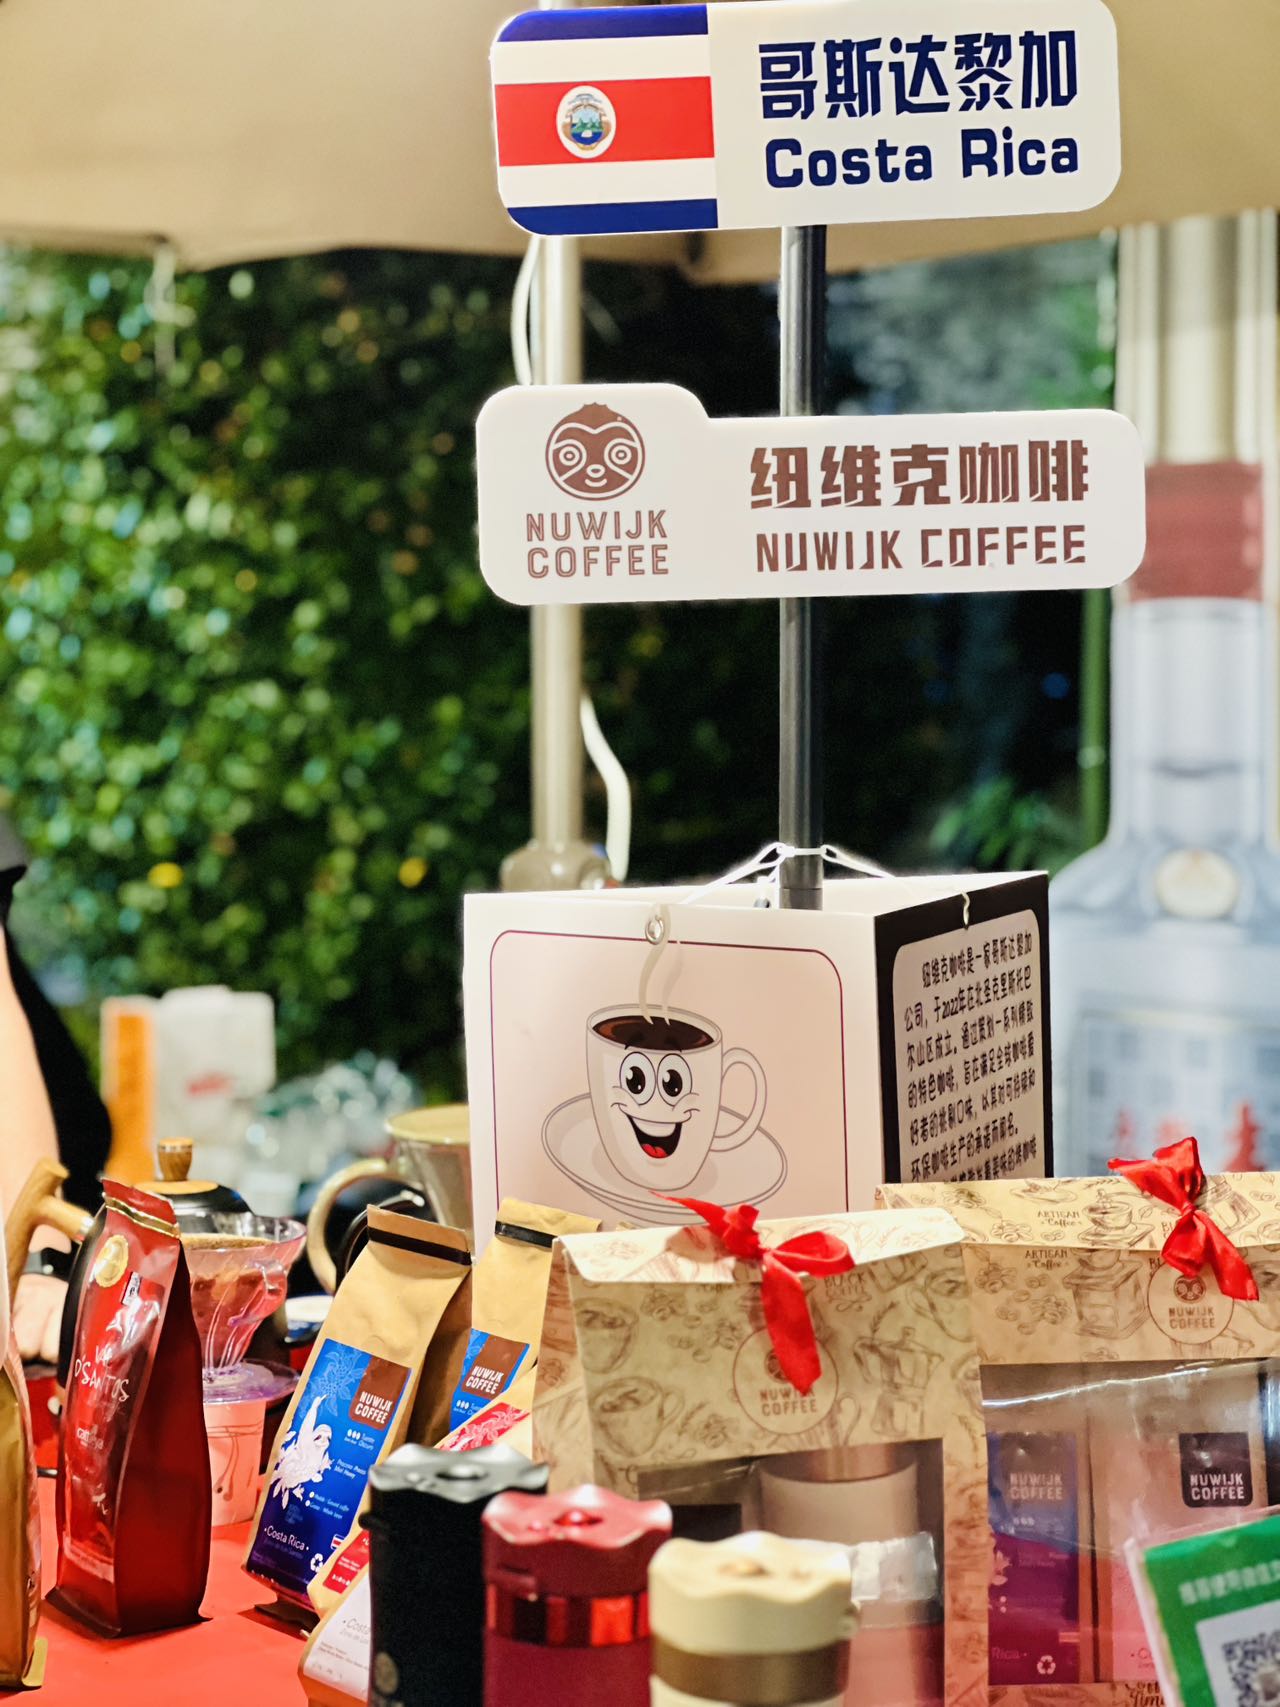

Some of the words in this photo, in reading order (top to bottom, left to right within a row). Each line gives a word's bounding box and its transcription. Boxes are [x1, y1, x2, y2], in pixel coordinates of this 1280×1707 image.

[758, 31, 1078, 119] 哥斯达黎加
[765, 137, 933, 188] Costa
[960, 126, 1079, 179] Rica
[750, 439, 1088, 509] 纽维克咖啡
[526, 509, 668, 542] NUWIJK
[756, 530, 904, 573] NUWIJK
[921, 524, 1087, 568] COFFEE
[526, 543, 669, 578] COFFEE
[1024, 1249, 1068, 1259] ARTISAN
[1168, 1306, 1215, 1317] NUWIJK
[1169, 1317, 1216, 1329] COFFEE
[471, 1365, 505, 1383] NUWIJK
[465, 1376, 500, 1395] COFFEE
[359, 1391, 394, 1412] NUWIJK
[762, 1399, 818, 1416] COFFEE
[354, 1403, 389, 1424] COFFEE
[1009, 1472, 1063, 1486] NUWIJK
[1189, 1472, 1244, 1486] NUWIJK
[1010, 1486, 1064, 1500] COFFEE
[1191, 1486, 1246, 1500] COFFEE
[266, 1525, 288, 1544] Costa
[288, 1534, 305, 1551] Rica
